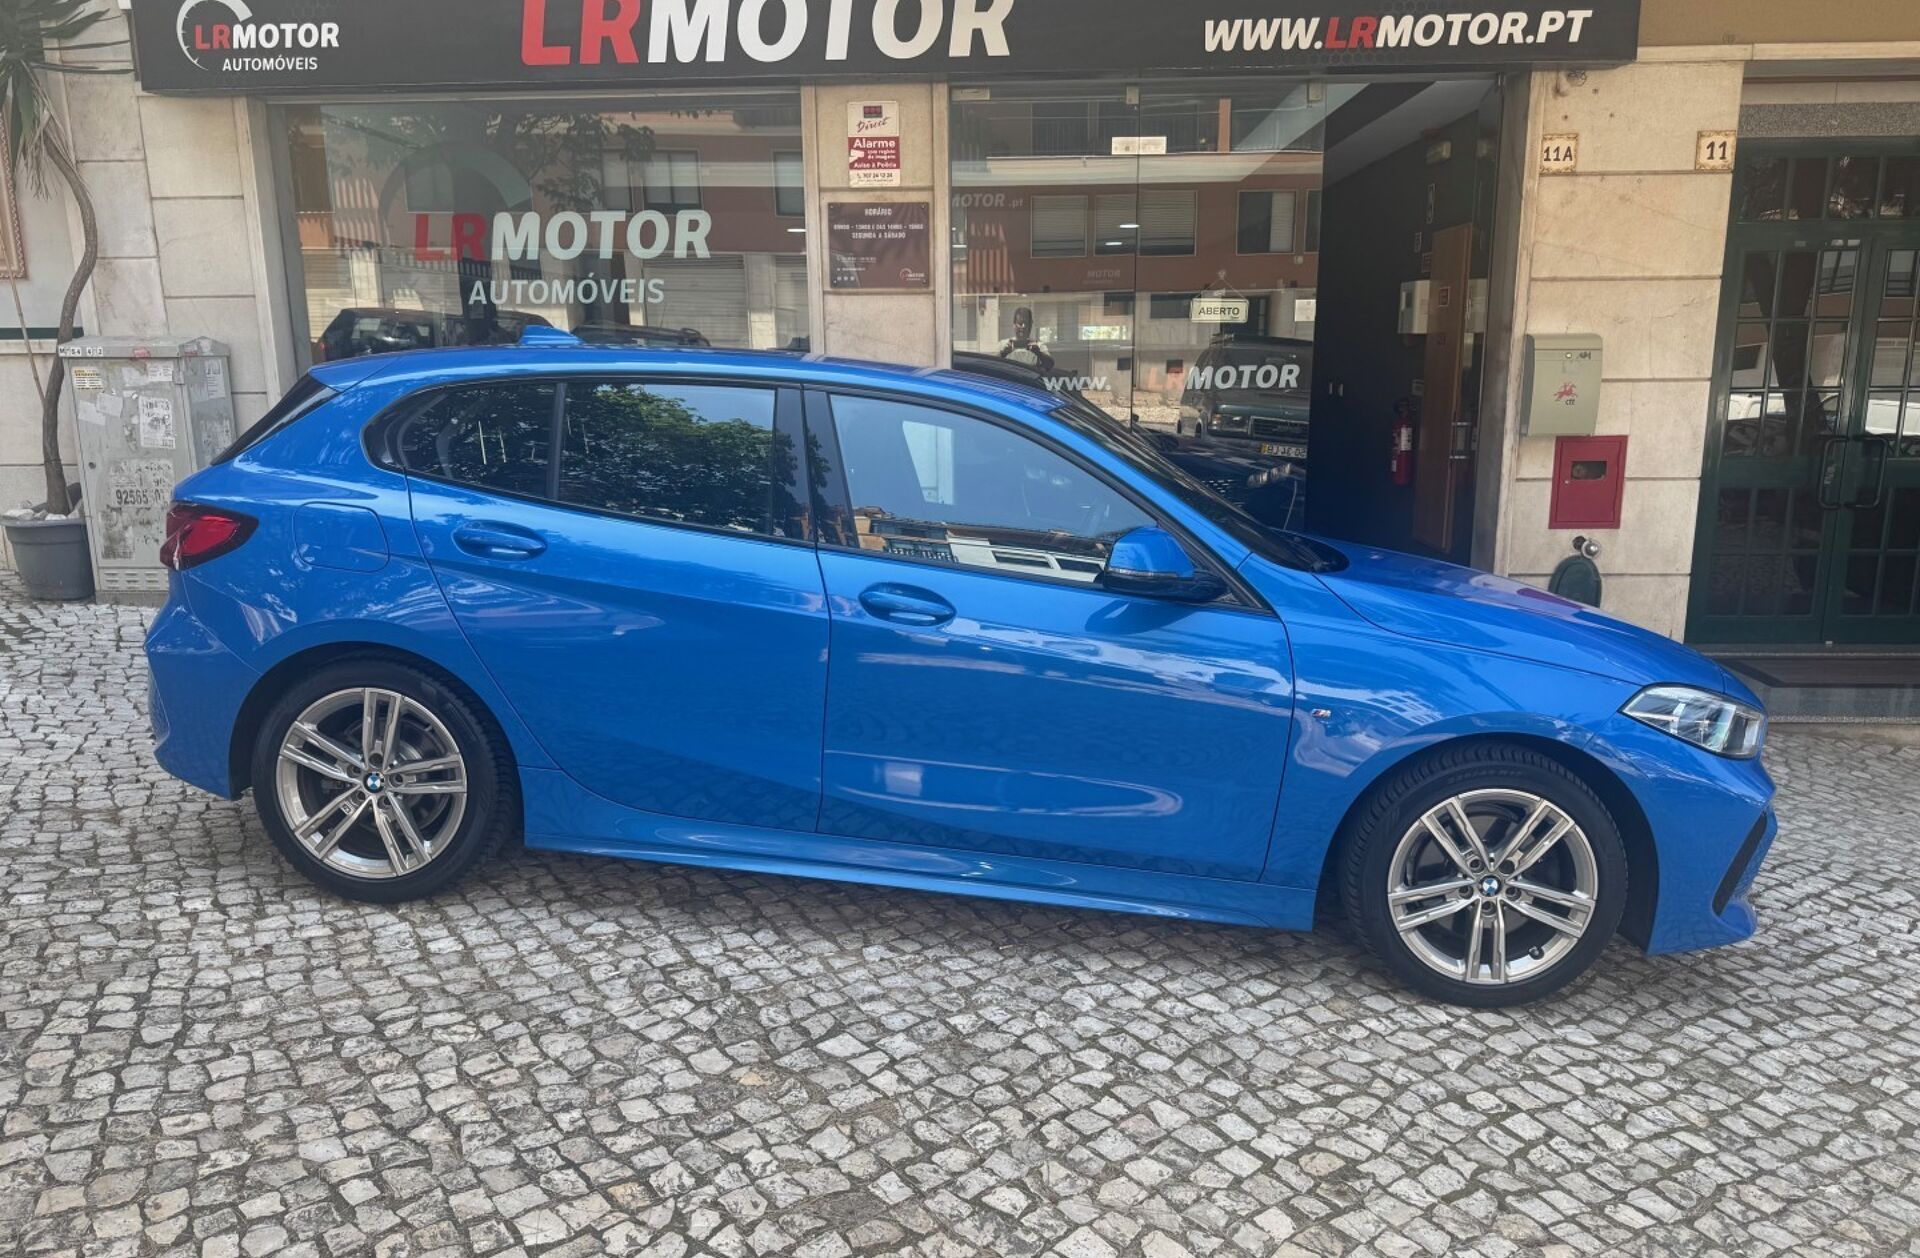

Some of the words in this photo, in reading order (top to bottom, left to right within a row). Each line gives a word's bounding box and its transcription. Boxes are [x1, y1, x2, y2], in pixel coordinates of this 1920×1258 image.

[194, 22, 340, 50] LRMOTOR
[521, 0, 1010, 65] LRMOTOR
[1204, 9, 1593, 52] WWW.LRMOTOR.PT
[222, 54, 318, 71] AUTOMÓVEIS
[853, 138, 896, 148] Alarme
[1706, 140, 1728, 160] 11
[1543, 145, 1573, 162] 11A
[414, 209, 712, 262] LRMOTOR
[468, 272, 665, 305] AUTOMÓVEIS
[1198, 306, 1240, 316] ABERTO
[1042, 376, 1112, 391] www.
